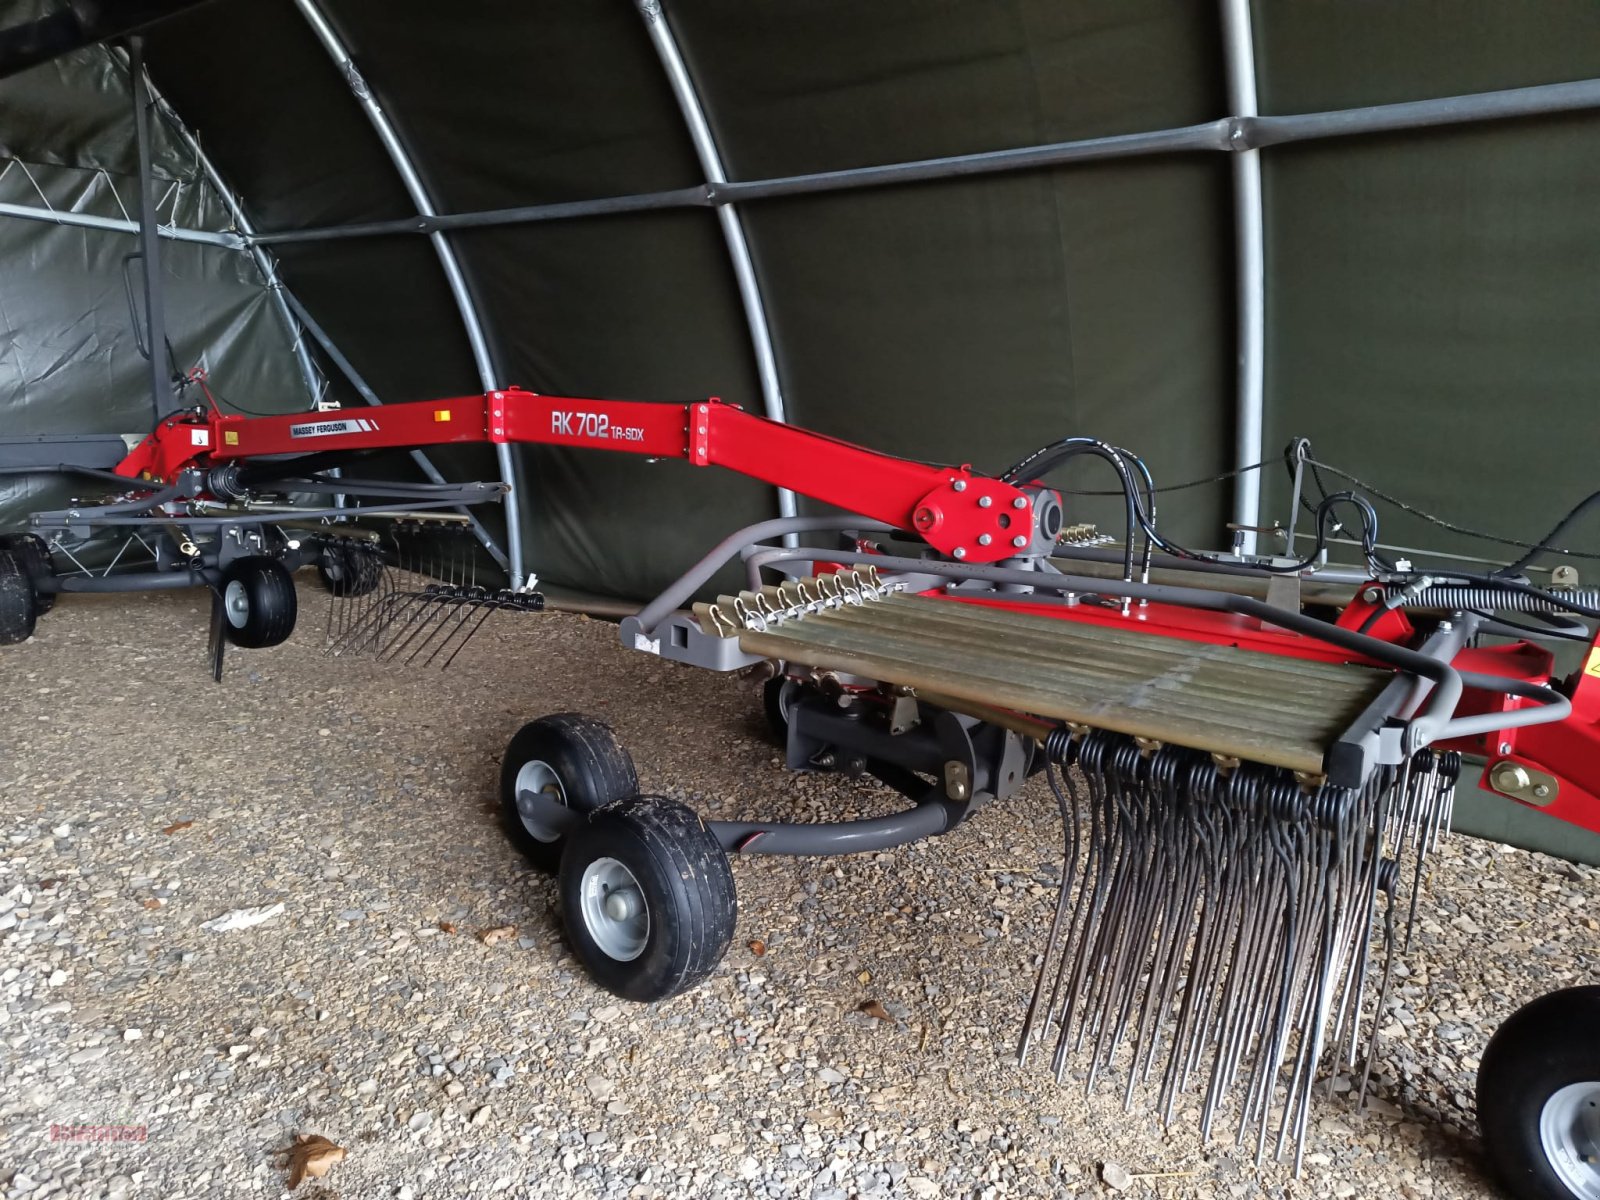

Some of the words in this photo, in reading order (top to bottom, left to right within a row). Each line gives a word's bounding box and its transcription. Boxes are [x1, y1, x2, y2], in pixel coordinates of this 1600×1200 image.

[293, 426, 315, 435] MASSEY
[316, 423, 347, 433] FERGUSON
[552, 411, 574, 435] RK
[576, 412, 609, 438] 702
[611, 426, 644, 441] TR-SDX
